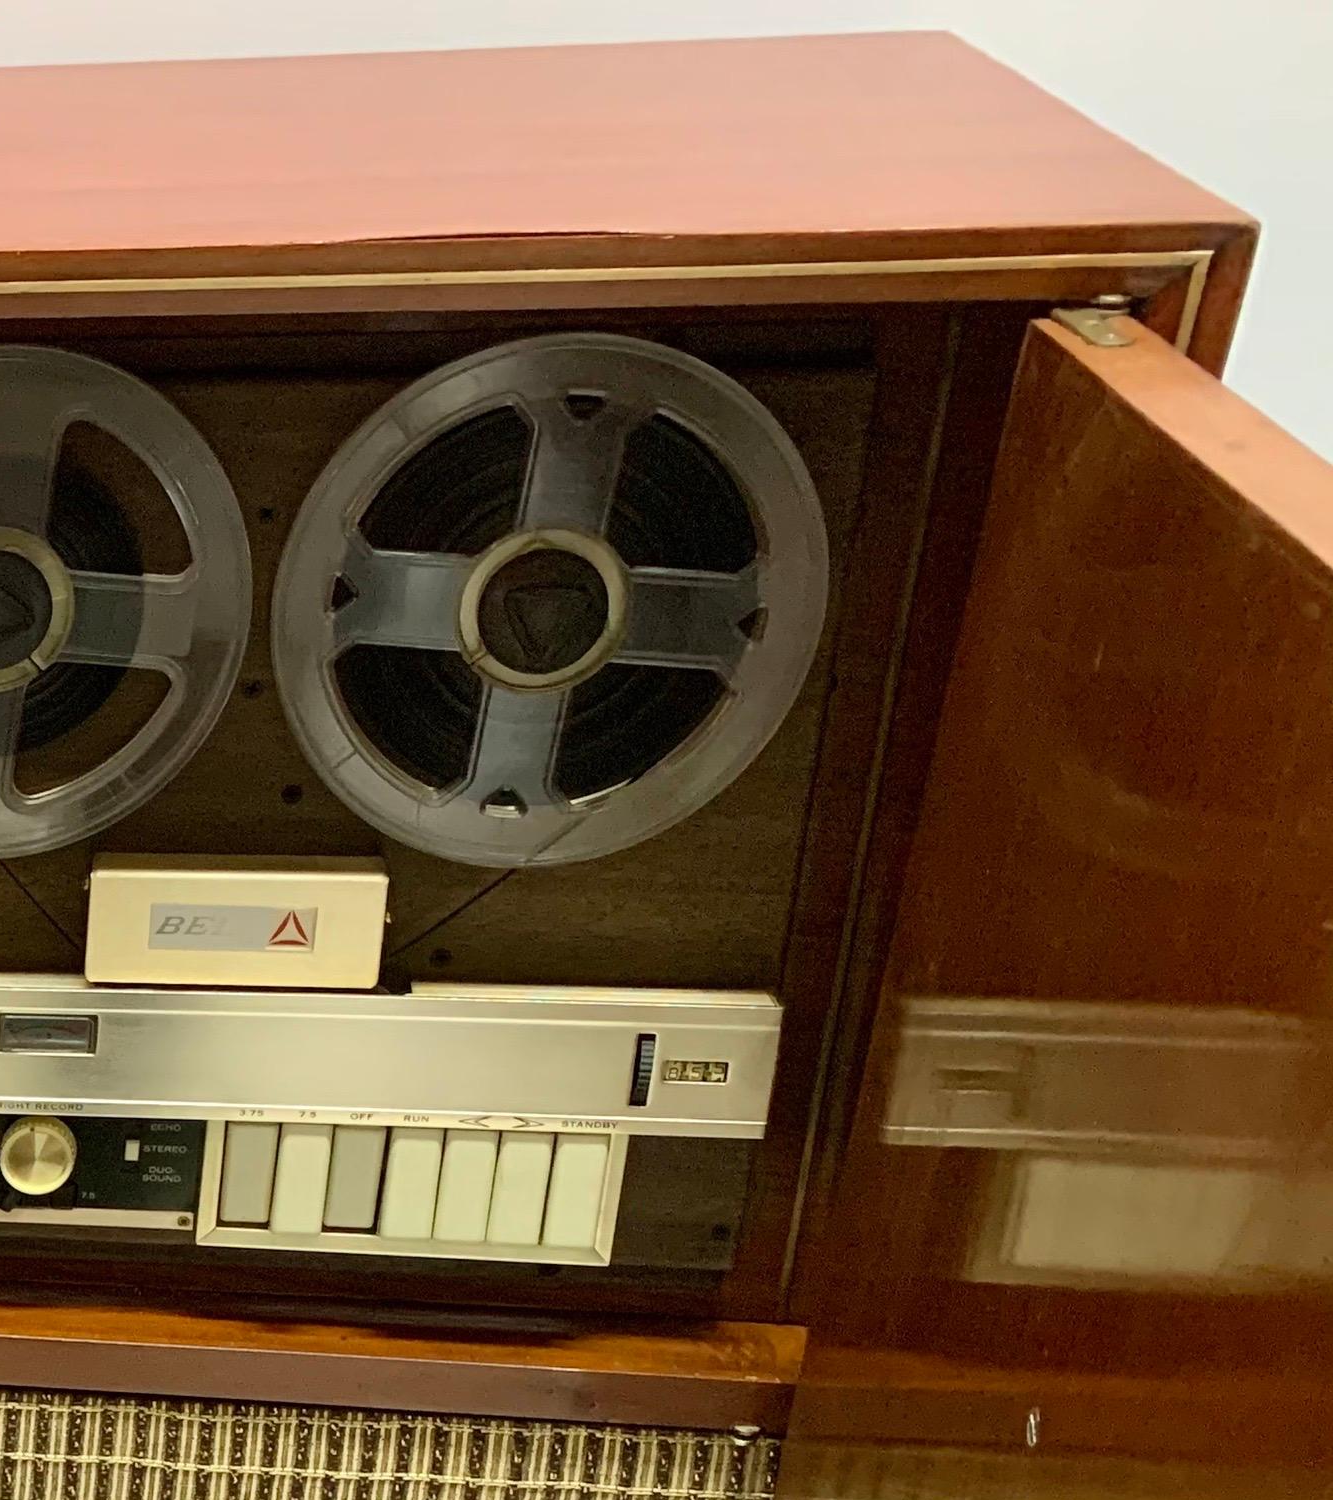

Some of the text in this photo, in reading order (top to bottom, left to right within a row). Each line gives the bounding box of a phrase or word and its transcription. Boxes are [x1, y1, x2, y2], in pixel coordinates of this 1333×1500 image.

[35, 1102, 84, 1111] RECORD
[349, 1112, 374, 1121] OFF
[403, 1114, 429, 1123] RUN
[150, 1123, 182, 1133] ECHO
[561, 1120, 619, 1129] STANDBY
[143, 1144, 188, 1154] STEREO
[142, 1174, 182, 1183] SOUND
